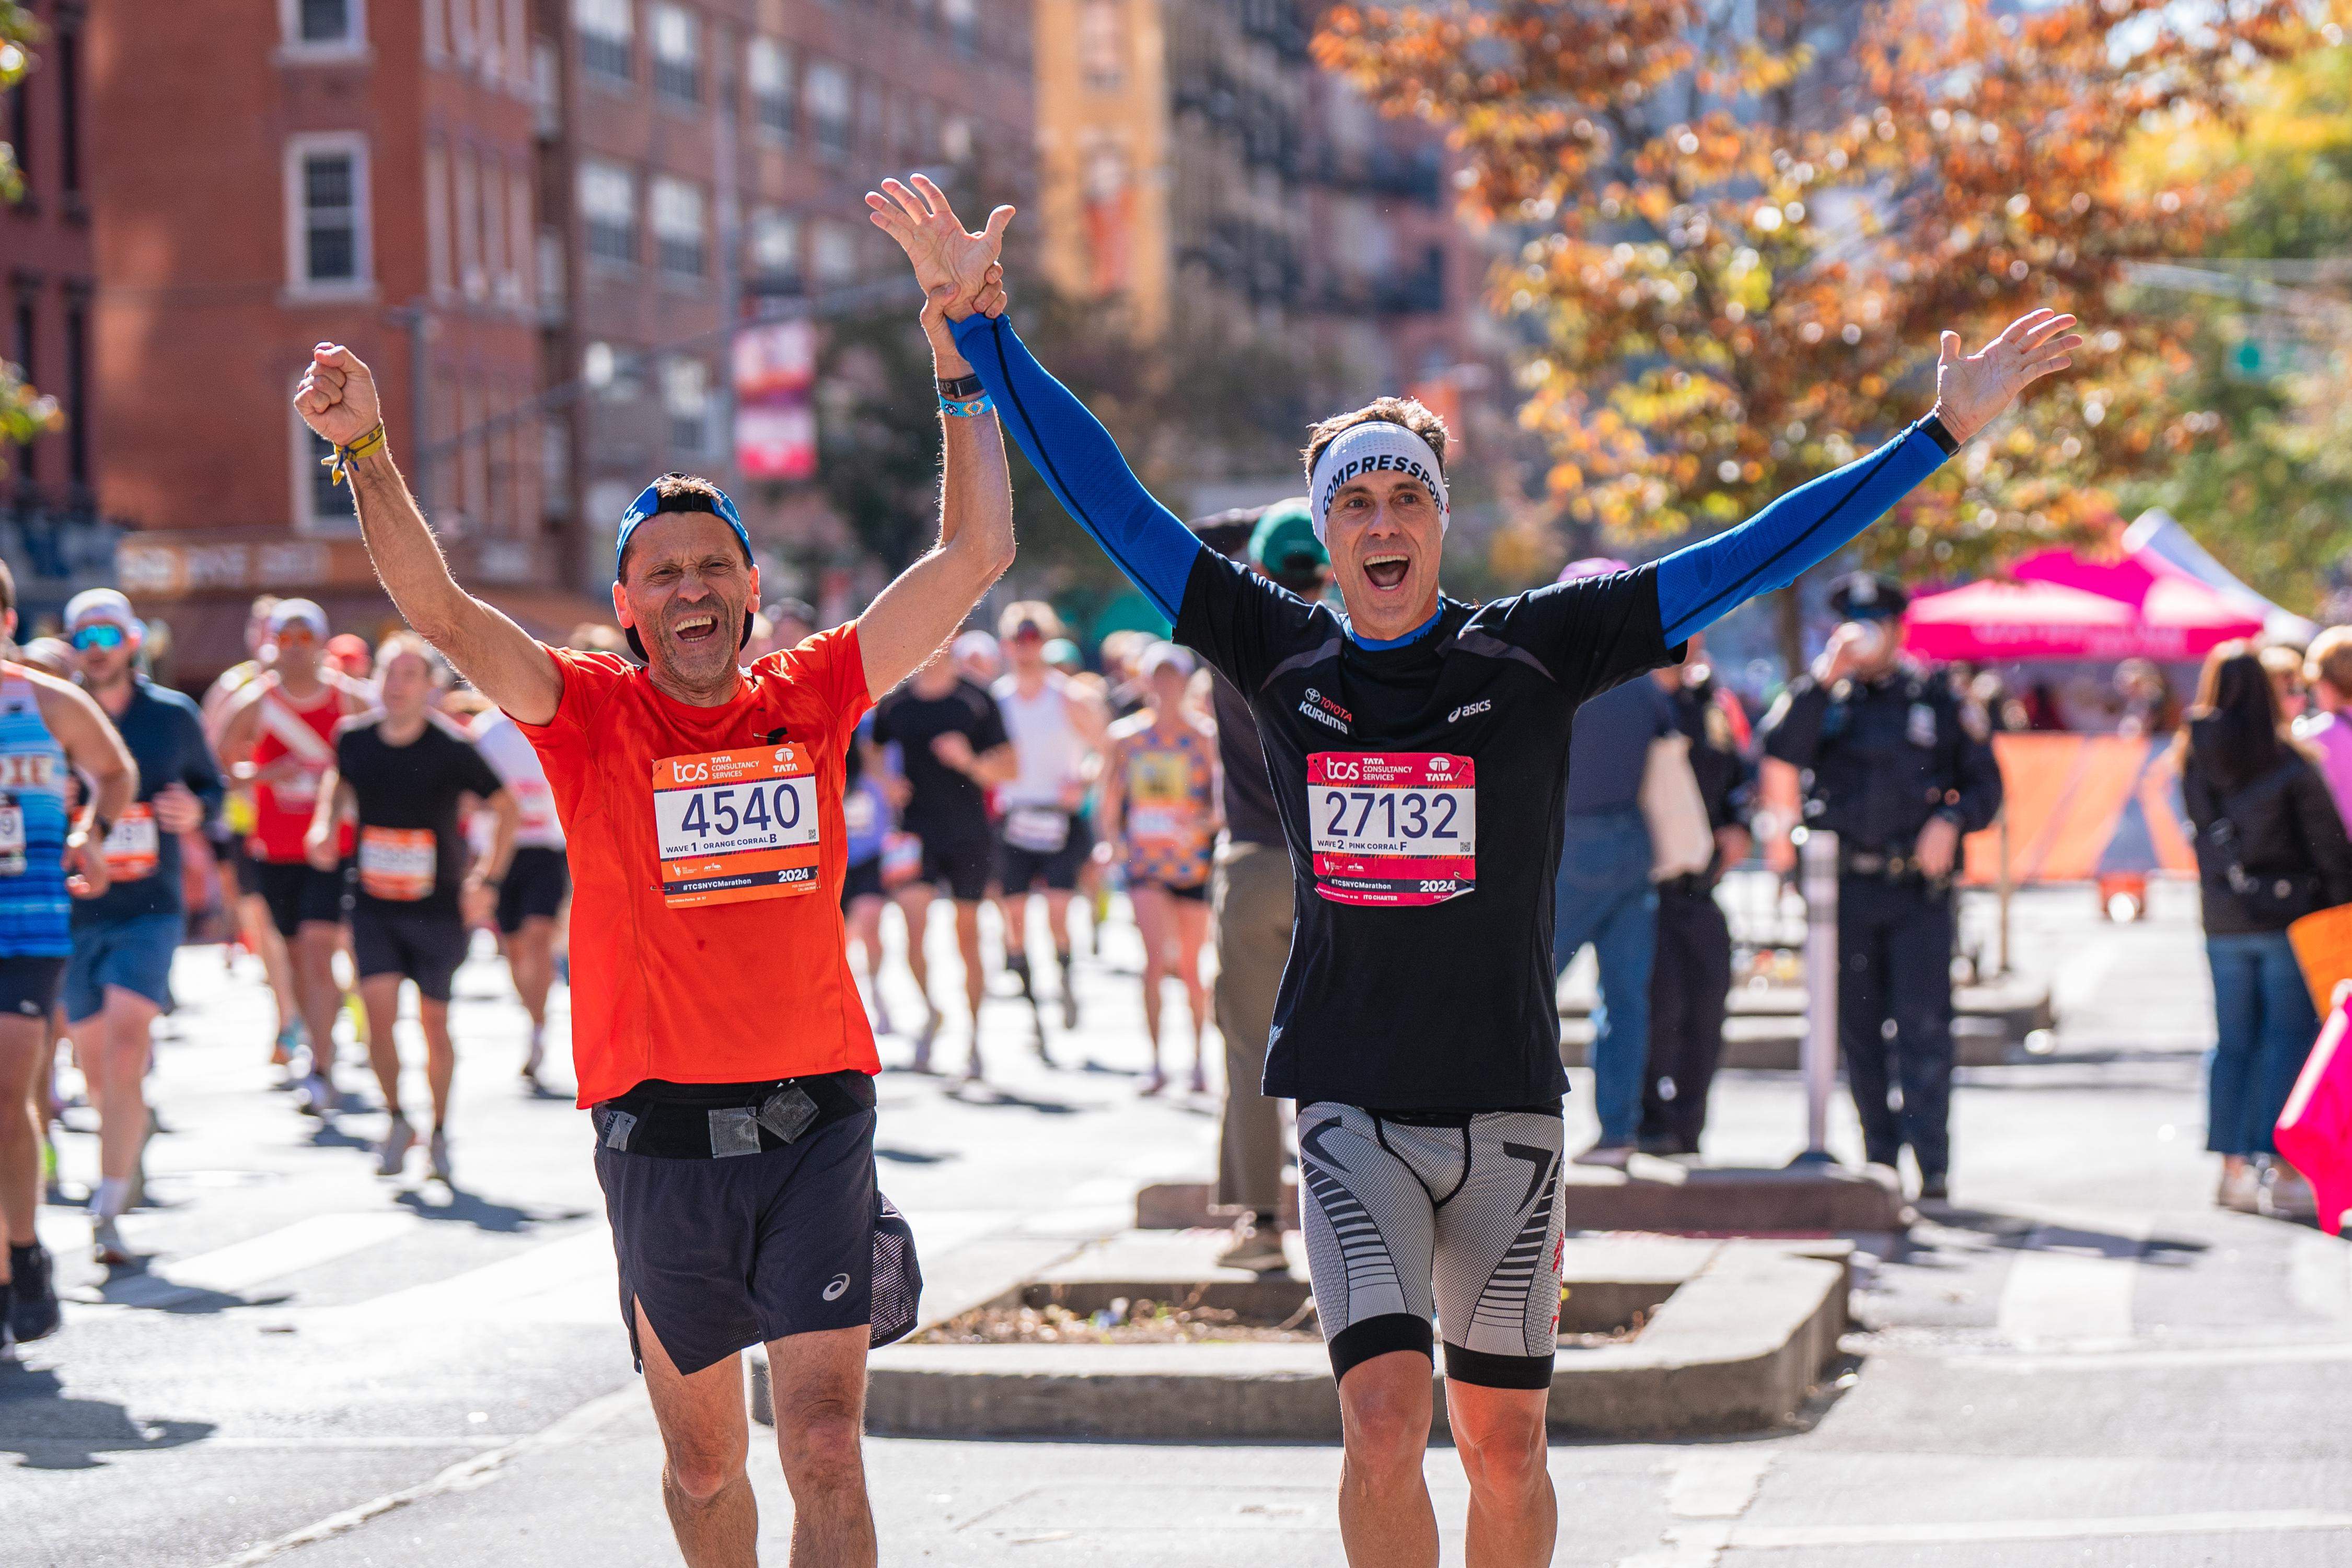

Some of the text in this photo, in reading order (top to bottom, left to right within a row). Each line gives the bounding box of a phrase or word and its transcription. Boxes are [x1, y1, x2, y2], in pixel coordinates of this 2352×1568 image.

[1323, 454, 1444, 516] COMPRESSPORT
[1320, 696, 1353, 723] TOYOTA
[711, 755, 732, 764] TATA
[711, 760, 760, 771] CONSULTANCY
[673, 761, 709, 783] tcs
[712, 770, 743, 780] SERVICES
[773, 763, 798, 773] TATA
[1326, 757, 1359, 781] tcs
[1425, 773, 1453, 782] TATA
[681, 783, 800, 838] 4540
[1325, 791, 1458, 839] 27132
[666, 833, 778, 853] WAVE 1 ORANGE CORRAL B
[1337, 840, 1345, 850] 2
[1400, 841, 1407, 852] F
[778, 868, 809, 883] 2024
[682, 877, 752, 891] #TCSNYCMarathon
[1331, 878, 1392, 890] #TCSNYCMarathon
[1420, 880, 1456, 892] 2024
